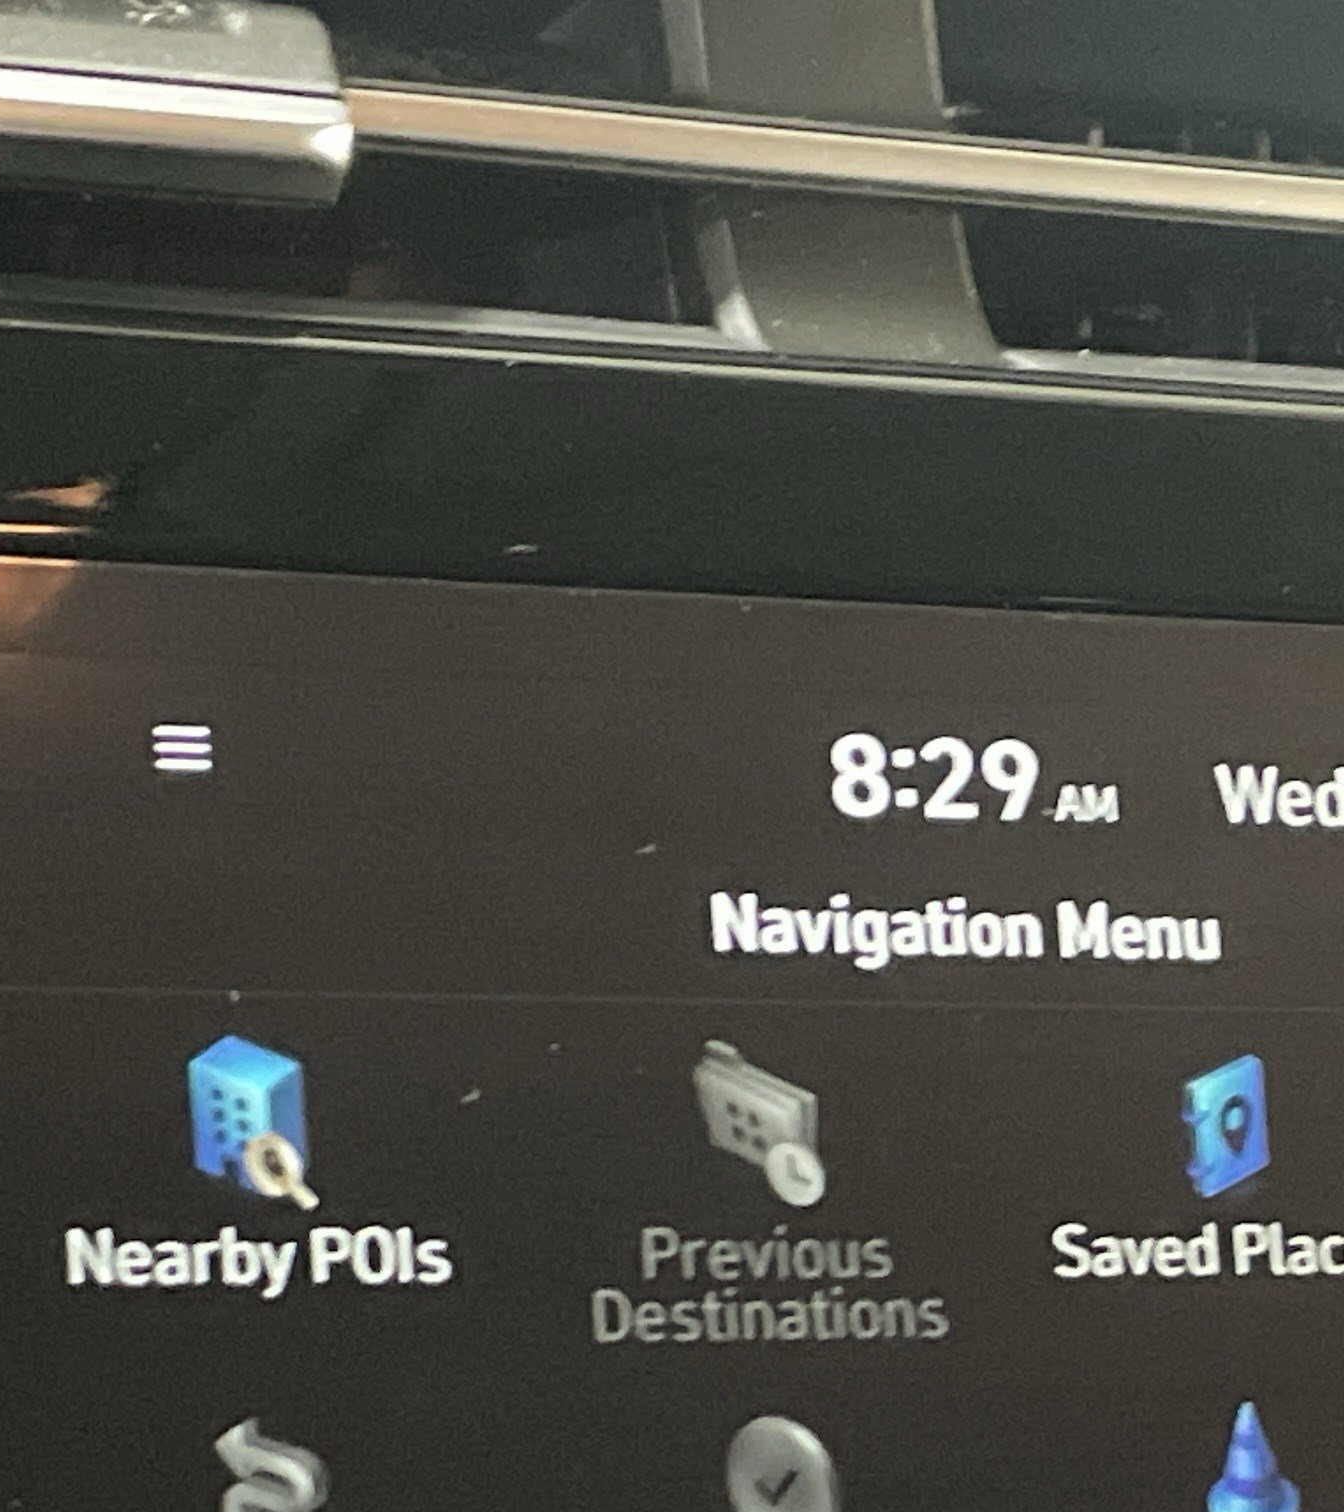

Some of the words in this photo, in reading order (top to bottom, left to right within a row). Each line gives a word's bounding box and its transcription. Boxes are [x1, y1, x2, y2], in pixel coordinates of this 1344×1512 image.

[829, 732, 1040, 822] 8:29
[1052, 783, 1121, 824] AM
[709, 890, 1045, 972] Navigation
[1055, 899, 1223, 963] Menu
[64, 1225, 298, 1300] Nearby
[308, 1224, 453, 1286] POIs
[640, 1223, 894, 1281] Previous
[1051, 1221, 1222, 1279] Saved
[591, 1284, 950, 1344] Destinations
